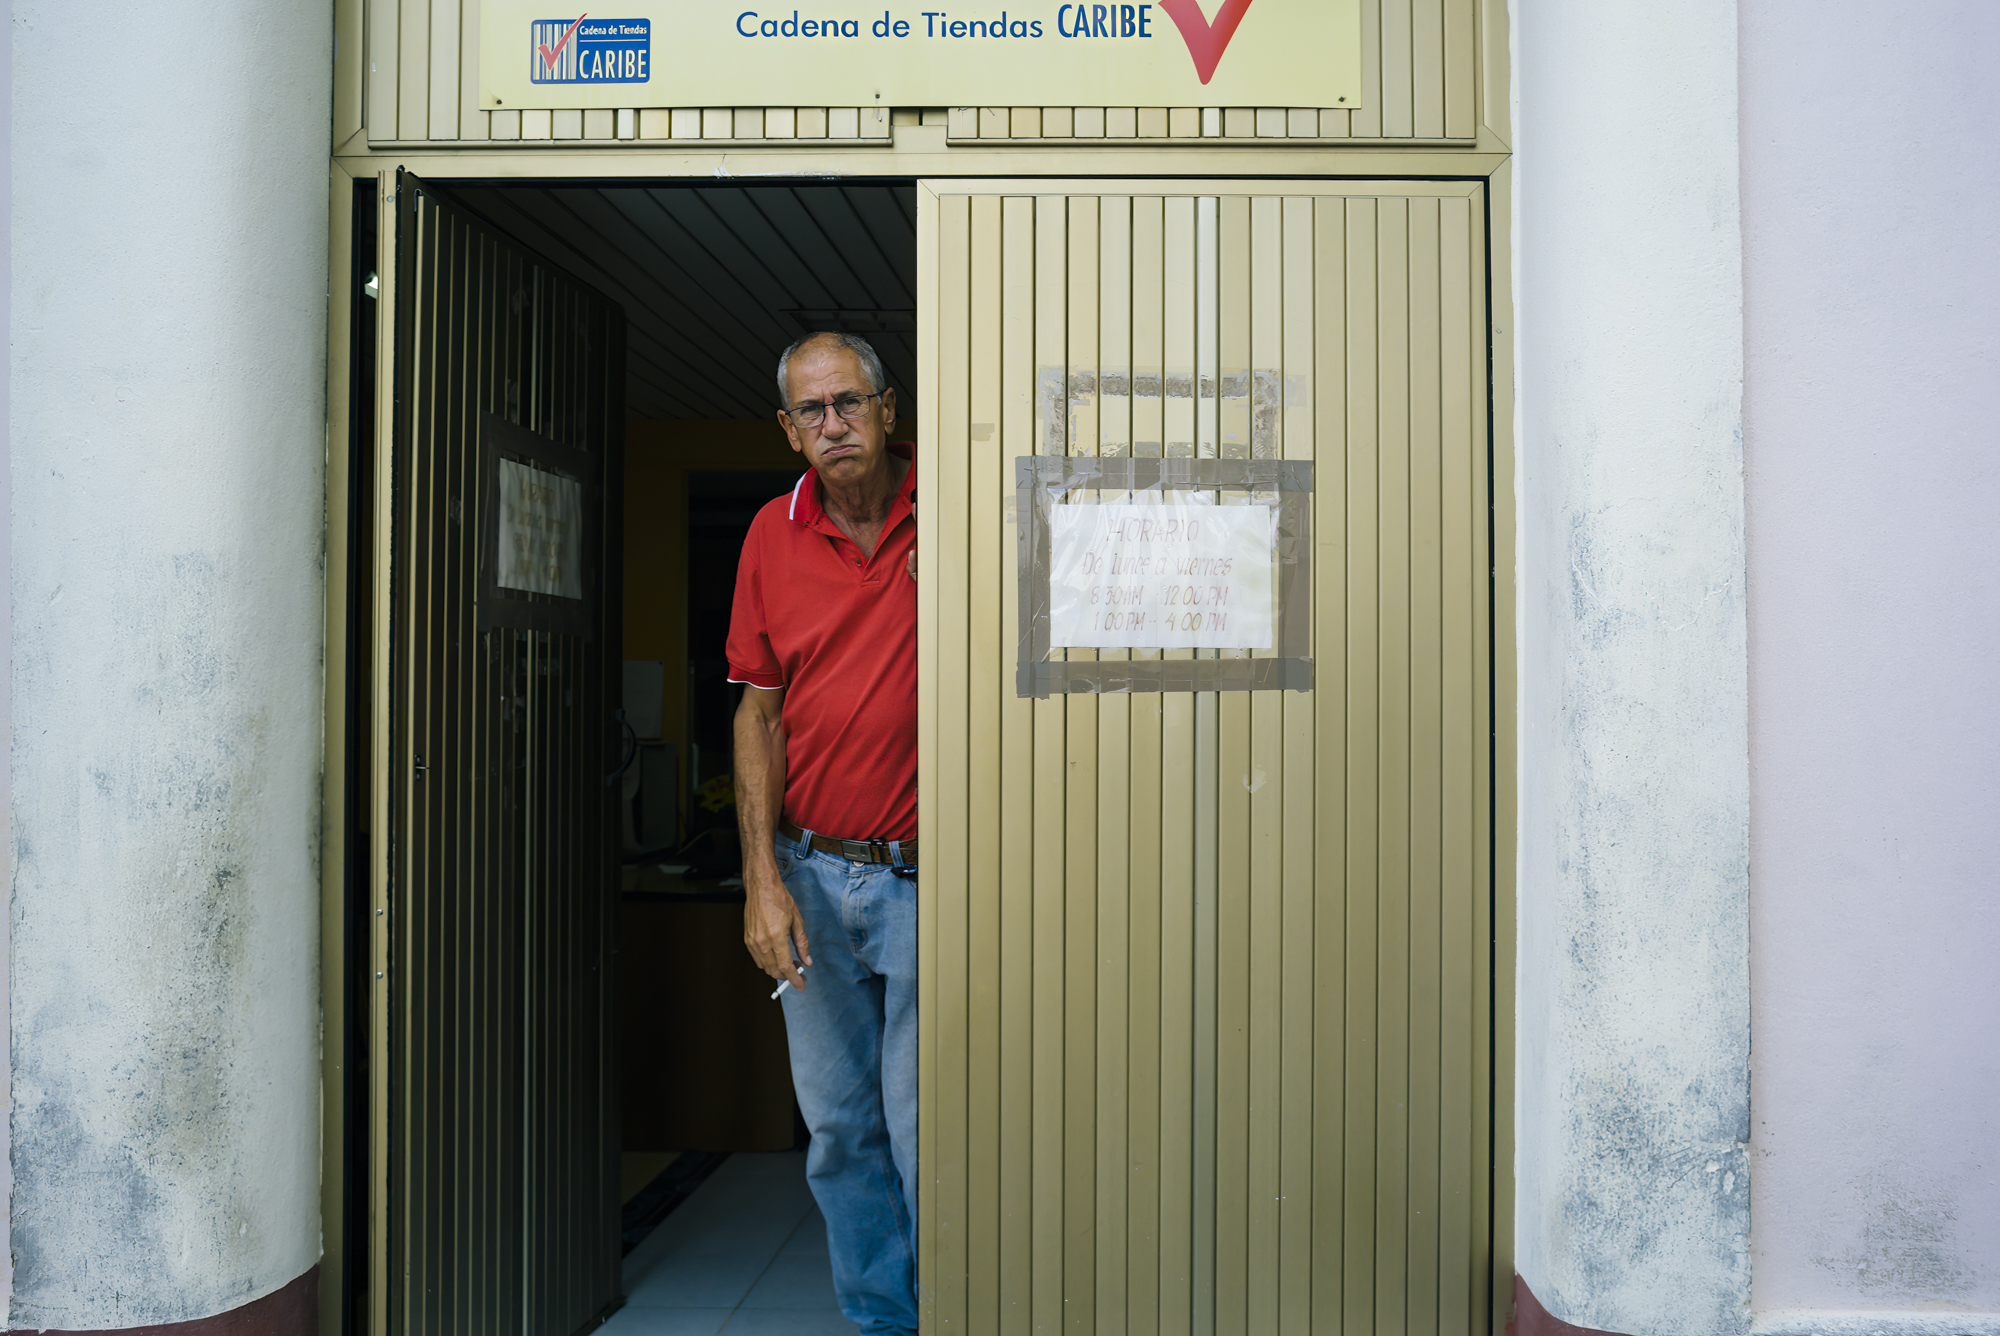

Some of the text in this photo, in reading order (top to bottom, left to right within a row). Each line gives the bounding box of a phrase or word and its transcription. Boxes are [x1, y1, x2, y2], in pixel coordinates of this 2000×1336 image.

[579, 25, 647, 35] Cadena de Tiendas
[736, 3, 1152, 38] Cadena de Tiendas CARIBE
[579, 49, 647, 79] CARIBE
[1106, 518, 1199, 541] HORARIO
